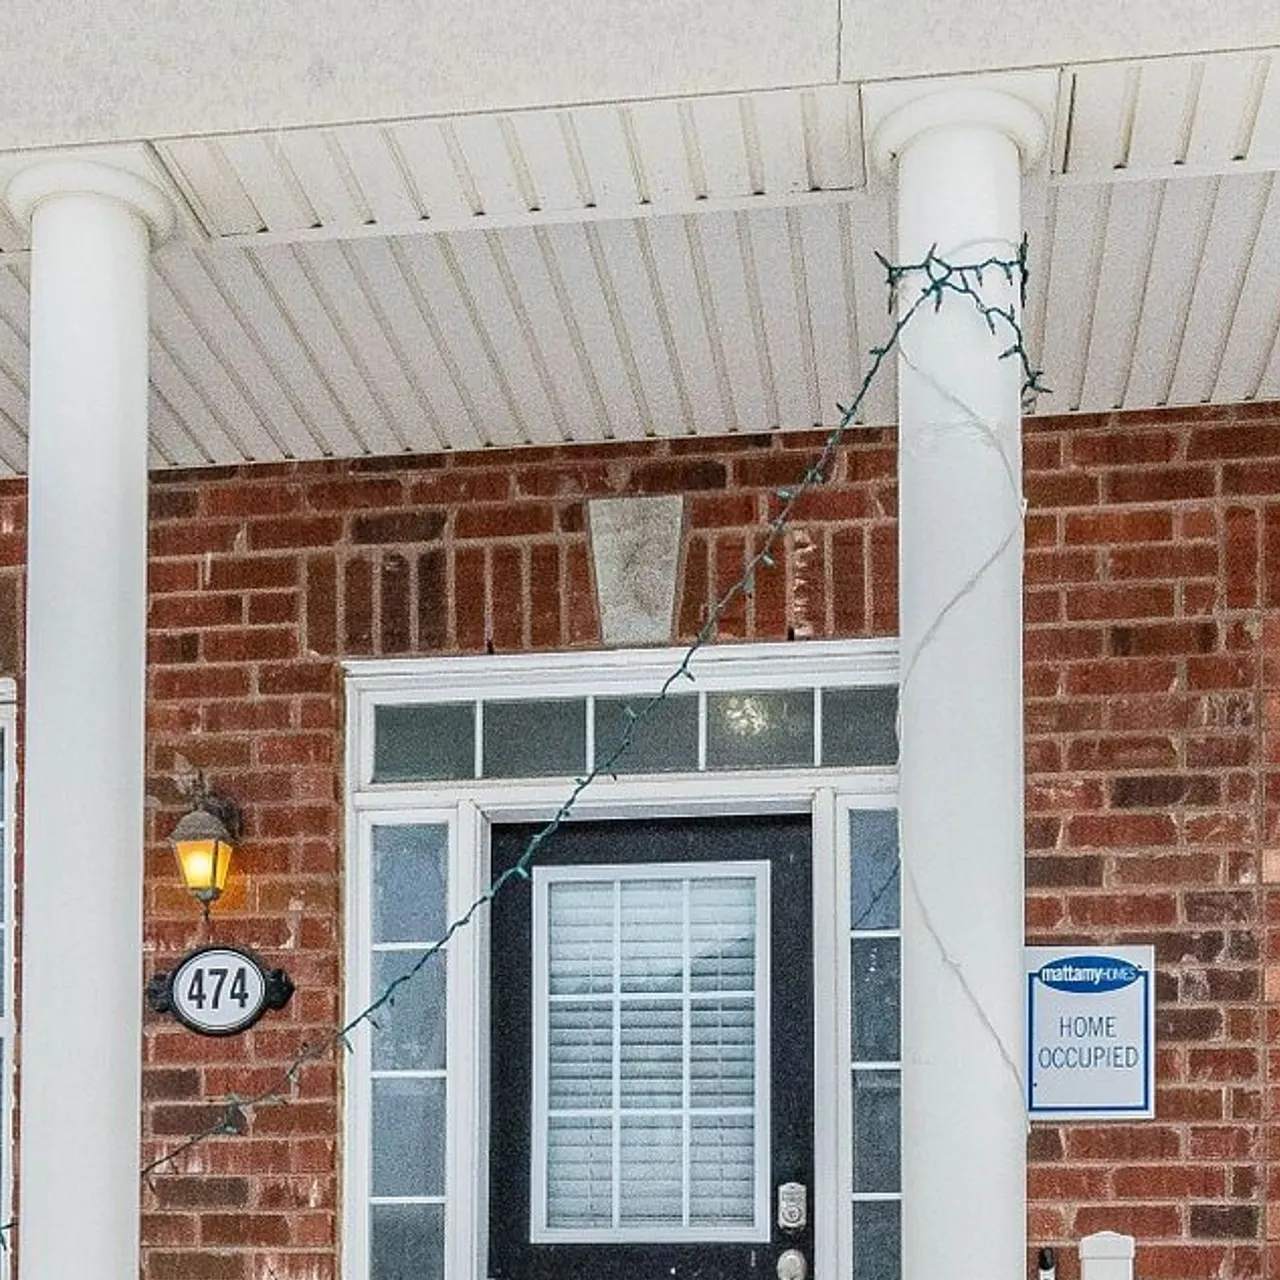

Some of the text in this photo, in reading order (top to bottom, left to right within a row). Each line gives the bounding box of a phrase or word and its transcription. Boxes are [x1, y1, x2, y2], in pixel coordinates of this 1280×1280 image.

[187, 967, 249, 1009] 474
[1059, 1016, 1118, 1038] HOME
[1038, 1046, 1139, 1069] OCCUPIED
